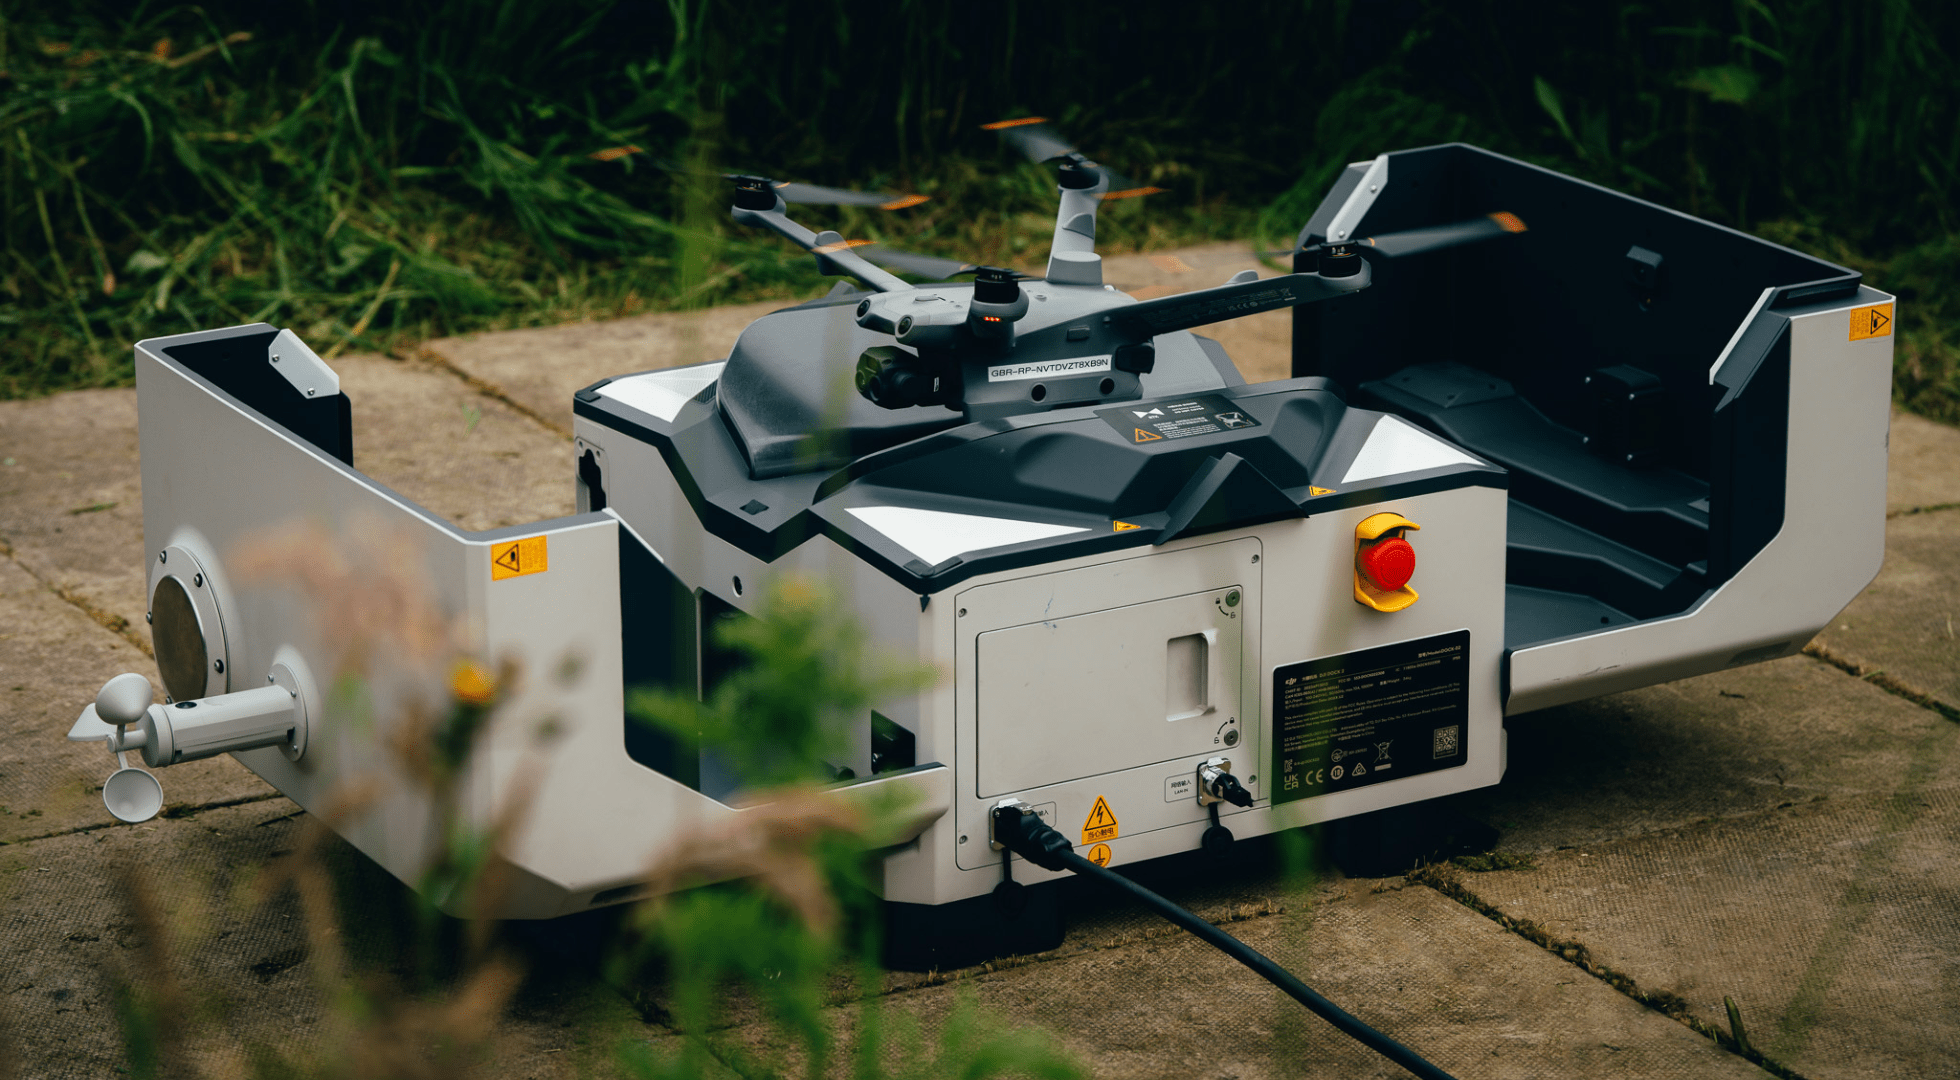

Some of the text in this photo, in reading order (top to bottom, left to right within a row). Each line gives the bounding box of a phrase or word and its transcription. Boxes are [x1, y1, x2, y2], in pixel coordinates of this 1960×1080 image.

[991, 358, 1108, 378] GBR-RP-NVTDVZT8XB9N
[1284, 774, 1298, 783] UK
[1306, 769, 1323, 786] CE
[1284, 782, 1298, 790] CA
[1088, 827, 1114, 839] 当心触电
